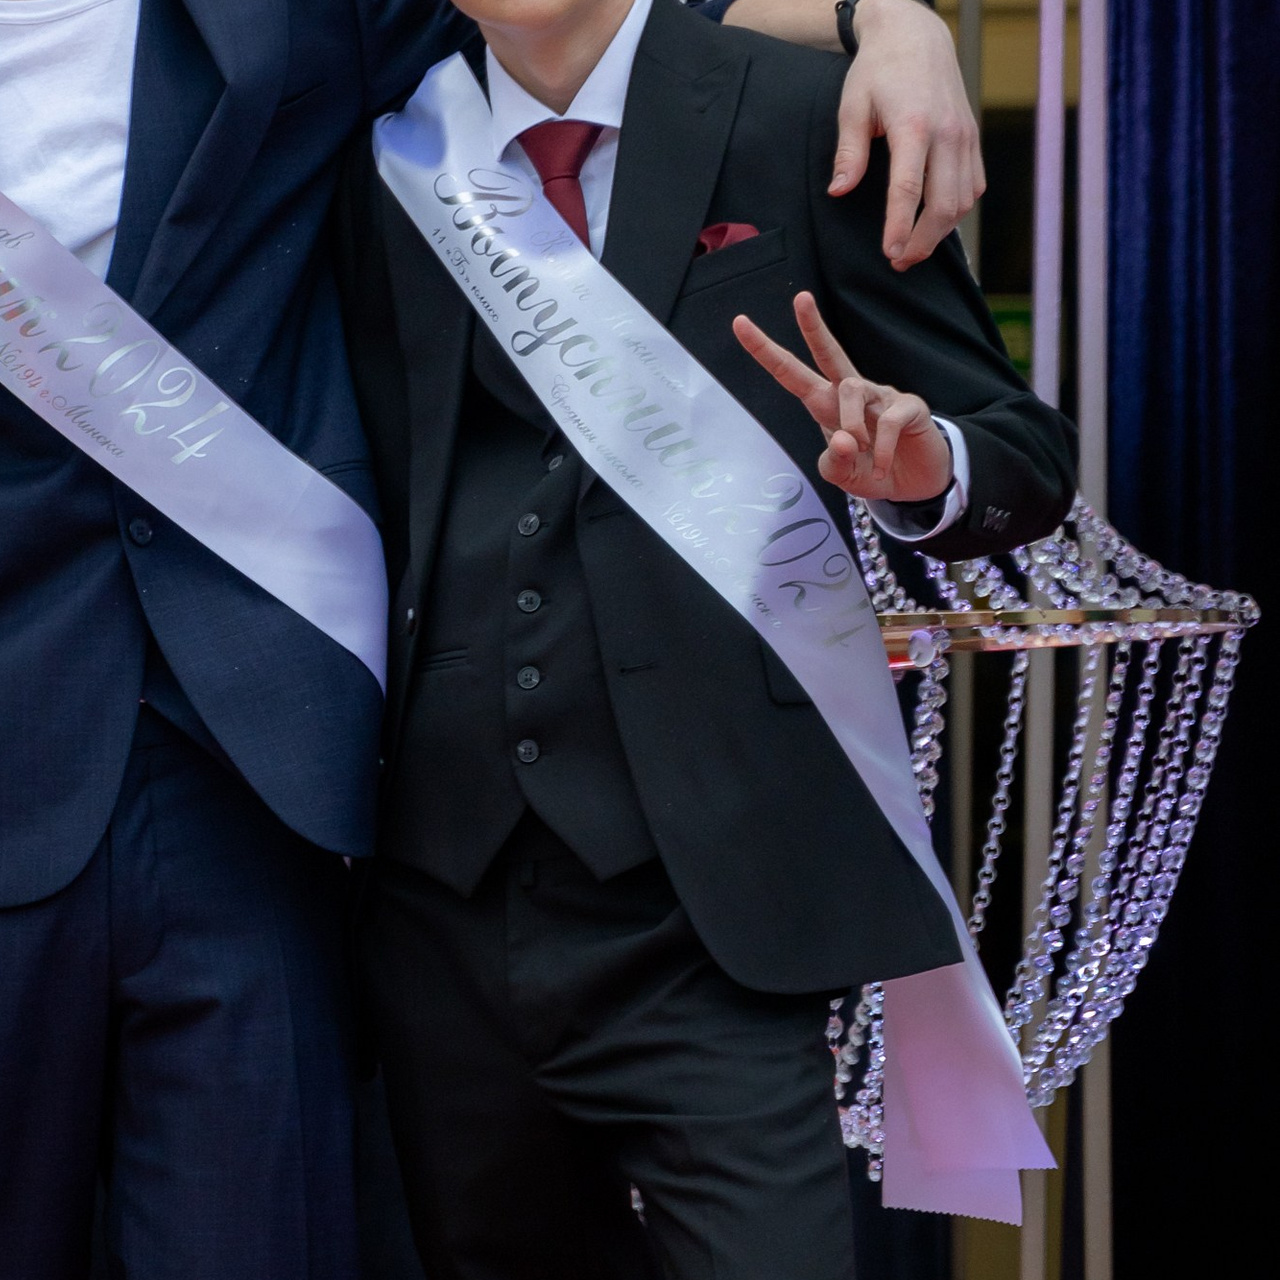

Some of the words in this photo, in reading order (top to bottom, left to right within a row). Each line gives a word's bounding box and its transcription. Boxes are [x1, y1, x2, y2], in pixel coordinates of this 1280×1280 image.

[432, 227, 447, 244] 11
[471, 286, 499, 323] класс
[433, 168, 734, 498] Выпускник
[38, 301, 231, 465] 2024
[550, 374, 597, 443] Средняя
